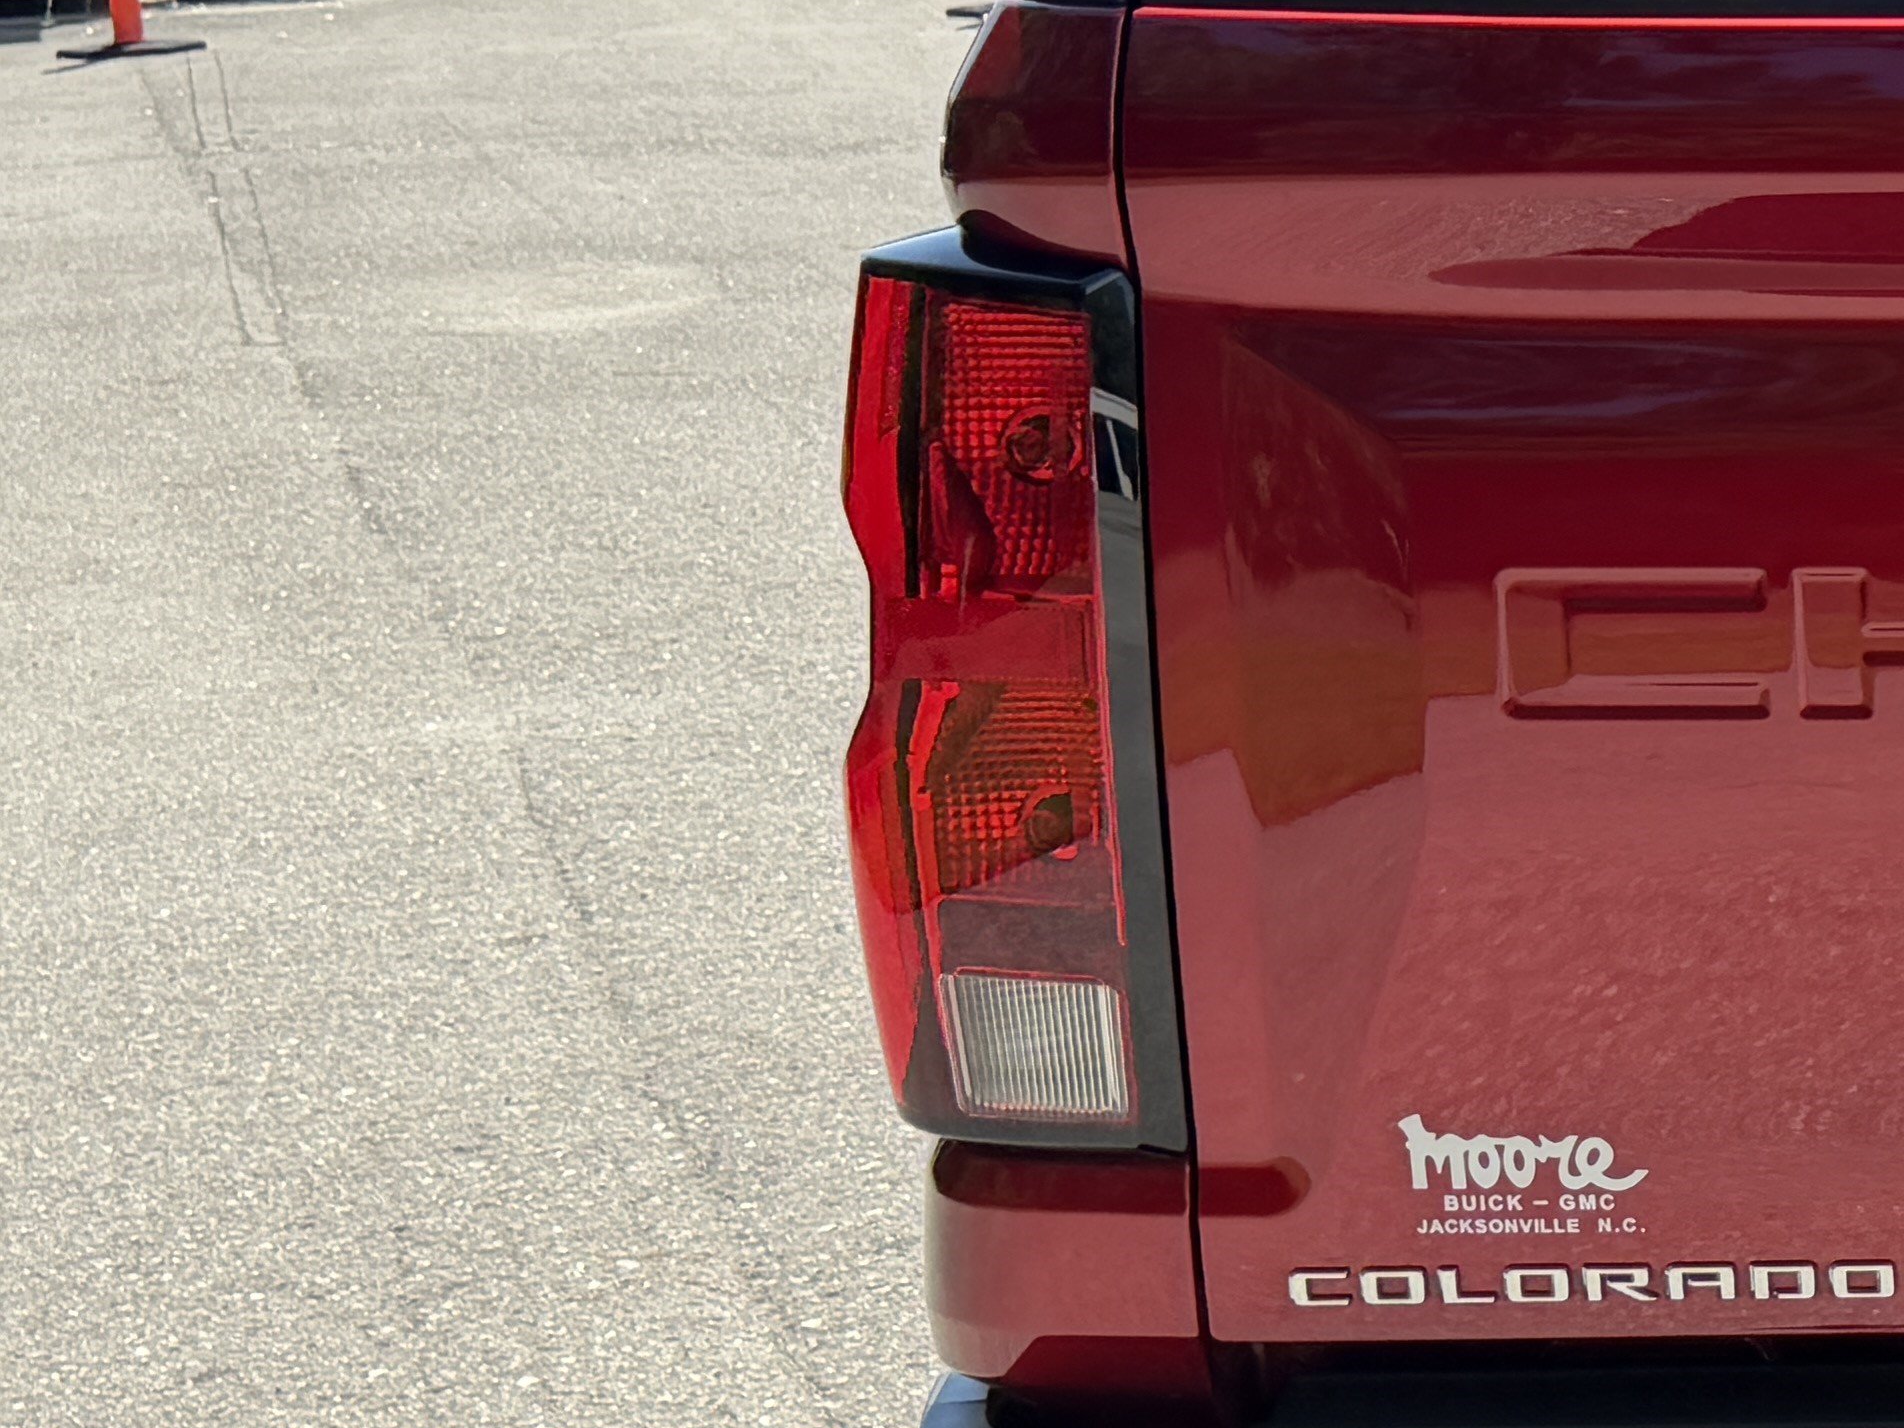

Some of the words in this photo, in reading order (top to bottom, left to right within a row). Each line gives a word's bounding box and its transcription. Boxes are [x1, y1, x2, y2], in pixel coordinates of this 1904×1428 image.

[1443, 1194, 1523, 1212] BUICK
[1558, 1193, 1616, 1211] GMC
[1416, 1218, 1581, 1234] JACKSONVILLE
[1597, 1218, 1647, 1234] N.C.
[1287, 1262, 1898, 1307] COLORADO
